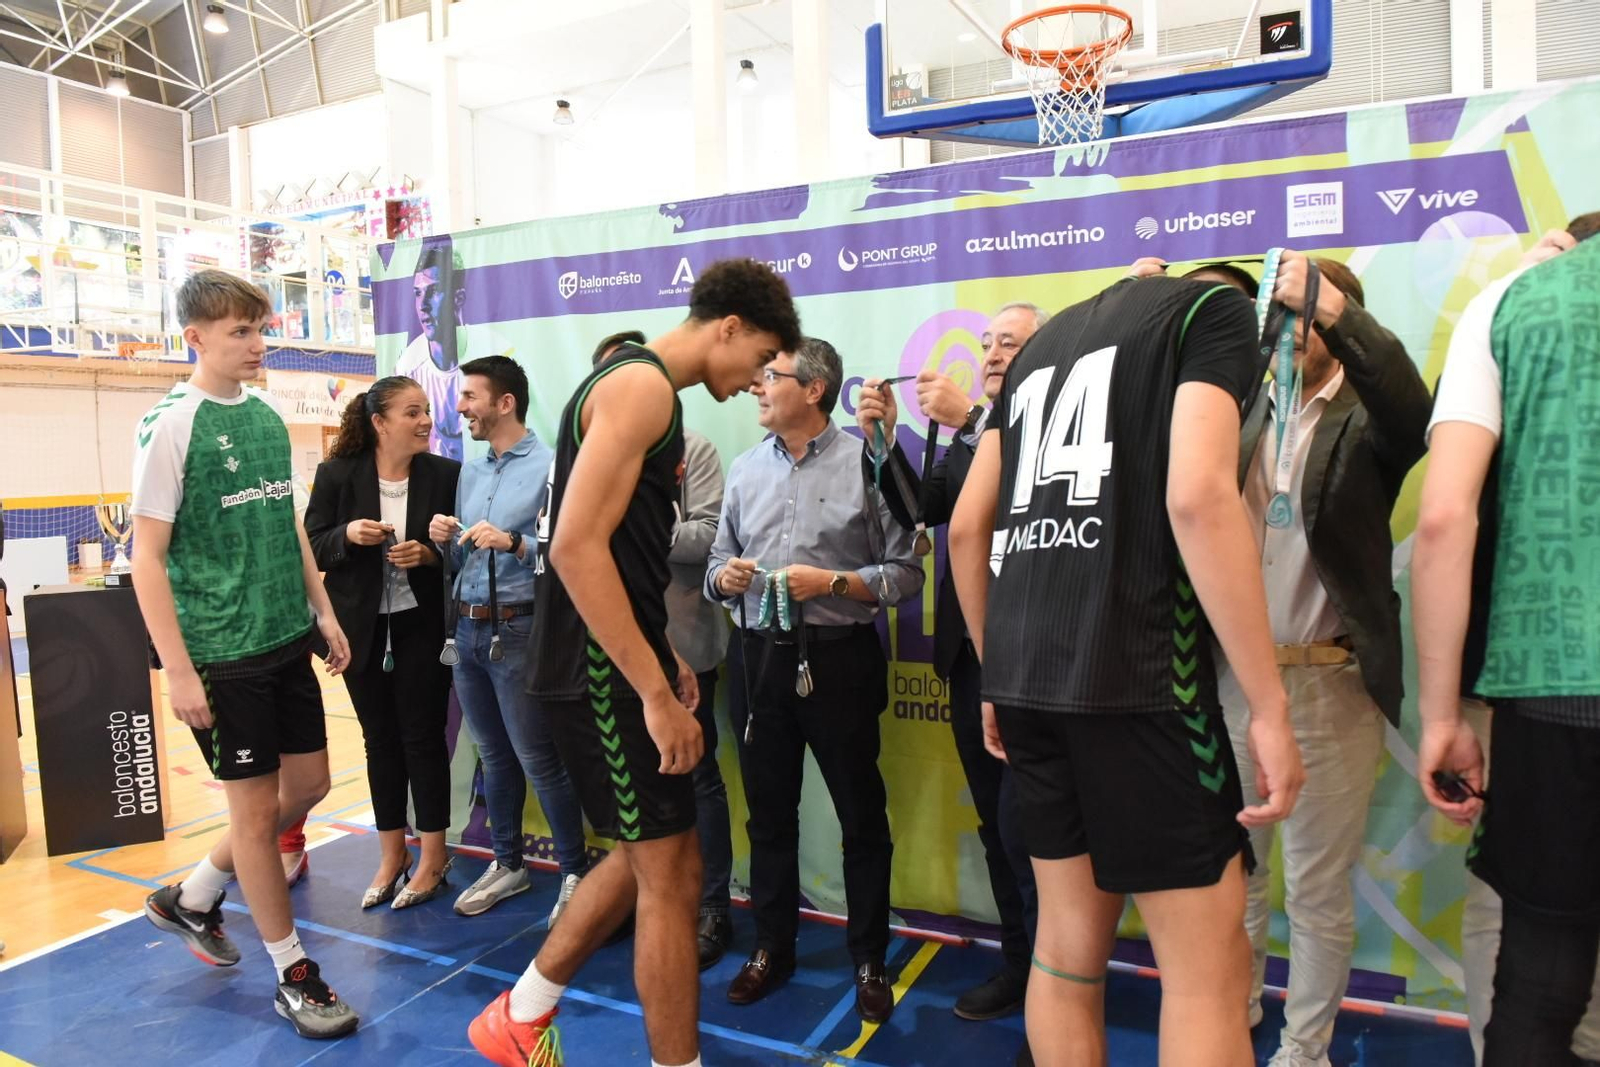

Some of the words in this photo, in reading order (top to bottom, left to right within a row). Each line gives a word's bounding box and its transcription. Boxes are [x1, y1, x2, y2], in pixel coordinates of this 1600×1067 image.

[892, 97, 918, 108] PLATA
[1293, 192, 1336, 208] SGM
[1418, 189, 1479, 210] vive
[1164, 209, 1256, 234] urbaser
[965, 224, 1105, 253] azulmarino
[861, 248, 899, 264] PONT
[900, 242, 938, 259] GRUP
[580, 271, 642, 290] baloncesto
[1009, 346, 1124, 514] 14
[264, 481, 291, 498] Cajal
[1007, 517, 1104, 554] MEDAC
[106, 710, 137, 819] baloncesto
